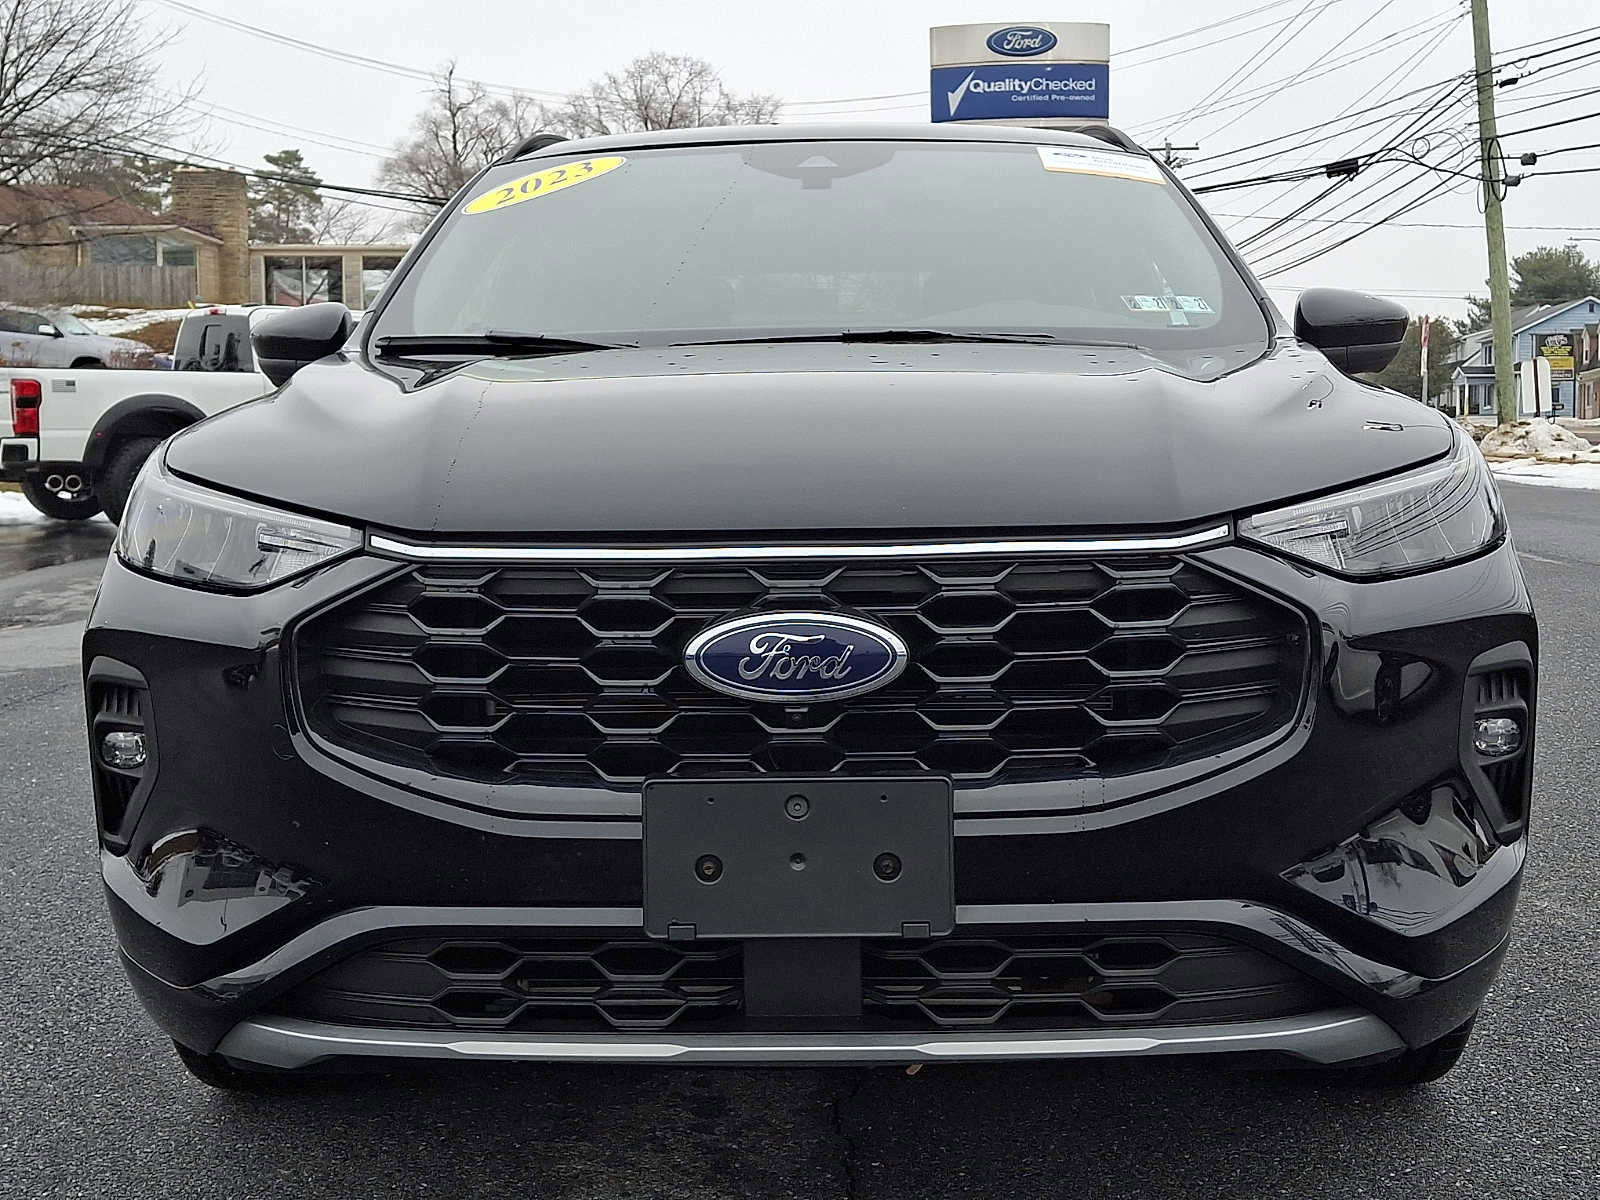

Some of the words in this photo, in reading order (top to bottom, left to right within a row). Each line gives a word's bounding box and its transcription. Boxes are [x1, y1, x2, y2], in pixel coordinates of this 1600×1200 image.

[1003, 31, 1042, 50] Ford
[1011, 94, 1049, 102] Certified
[496, 161, 594, 206] 2023
[738, 632, 854, 680] Ford
